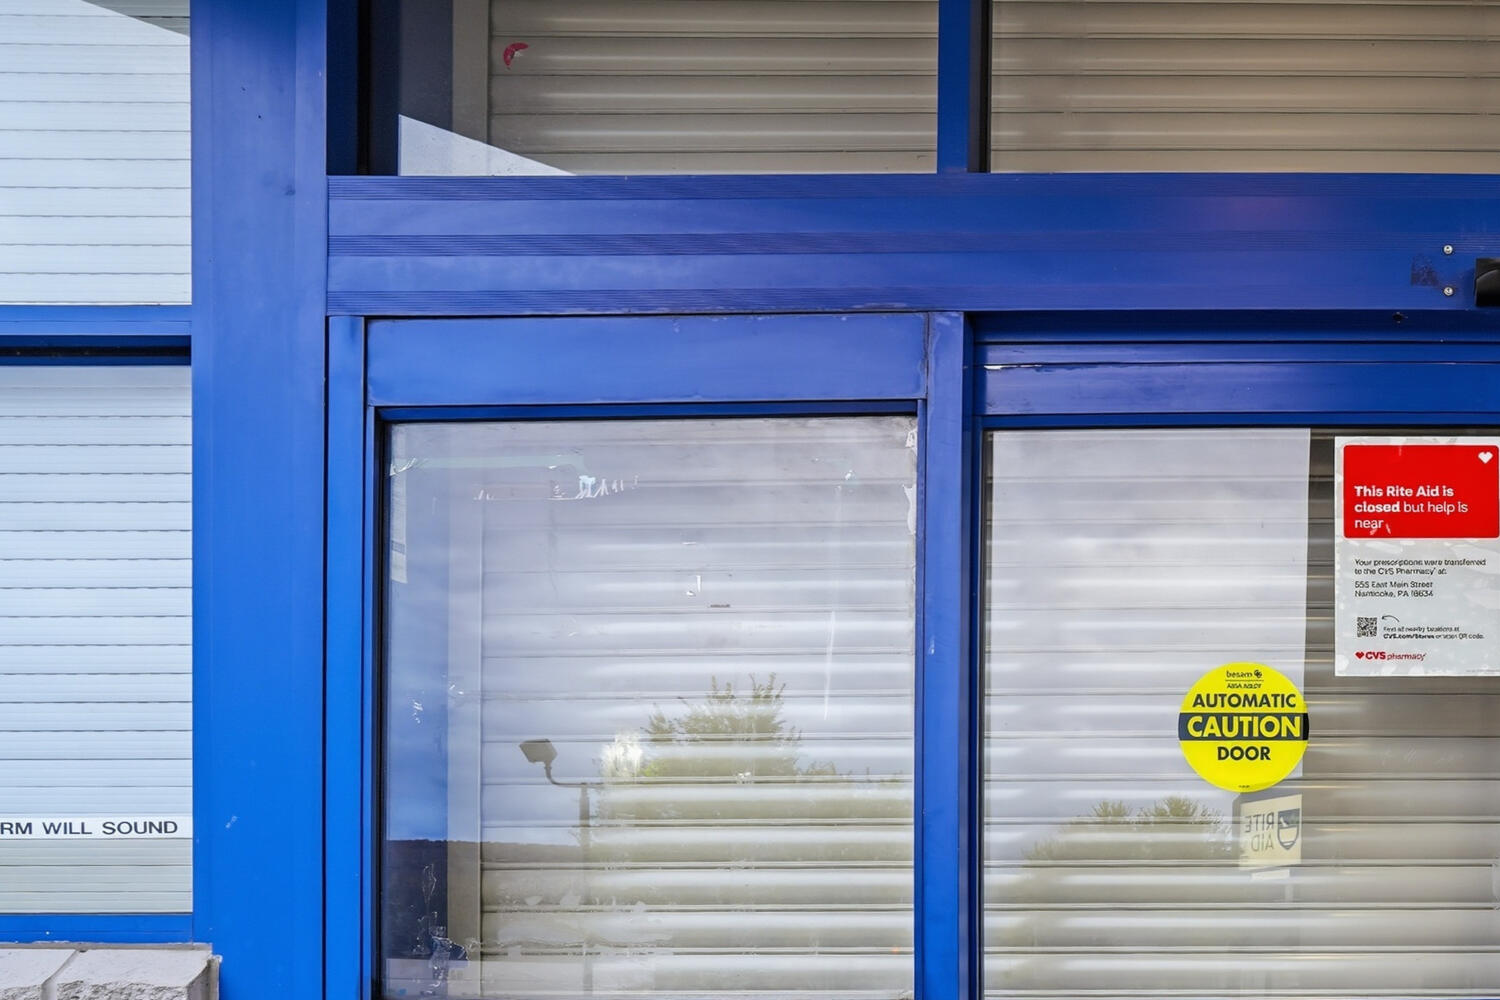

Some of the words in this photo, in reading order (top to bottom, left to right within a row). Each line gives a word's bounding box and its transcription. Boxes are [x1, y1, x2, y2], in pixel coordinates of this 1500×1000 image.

[1354, 485, 1383, 497] This
[1386, 485, 1413, 497] Rite
[1416, 485, 1440, 497] Aid
[1442, 485, 1454, 497] is
[1354, 501, 1400, 513] closed
[1403, 501, 1424, 513] but
[1427, 501, 1455, 516] help
[1458, 501, 1468, 513] is
[1365, 651, 1386, 660] CVS
[1226, 670, 1253, 678] besam
[1192, 693, 1297, 708] AUTOMATIC
[1187, 715, 1301, 738] CAUTION
[1217, 746, 1271, 761] DOOR
[0, 822, 33, 835] RM
[42, 822, 92, 835] WILL
[102, 821, 178, 835] SOUND
